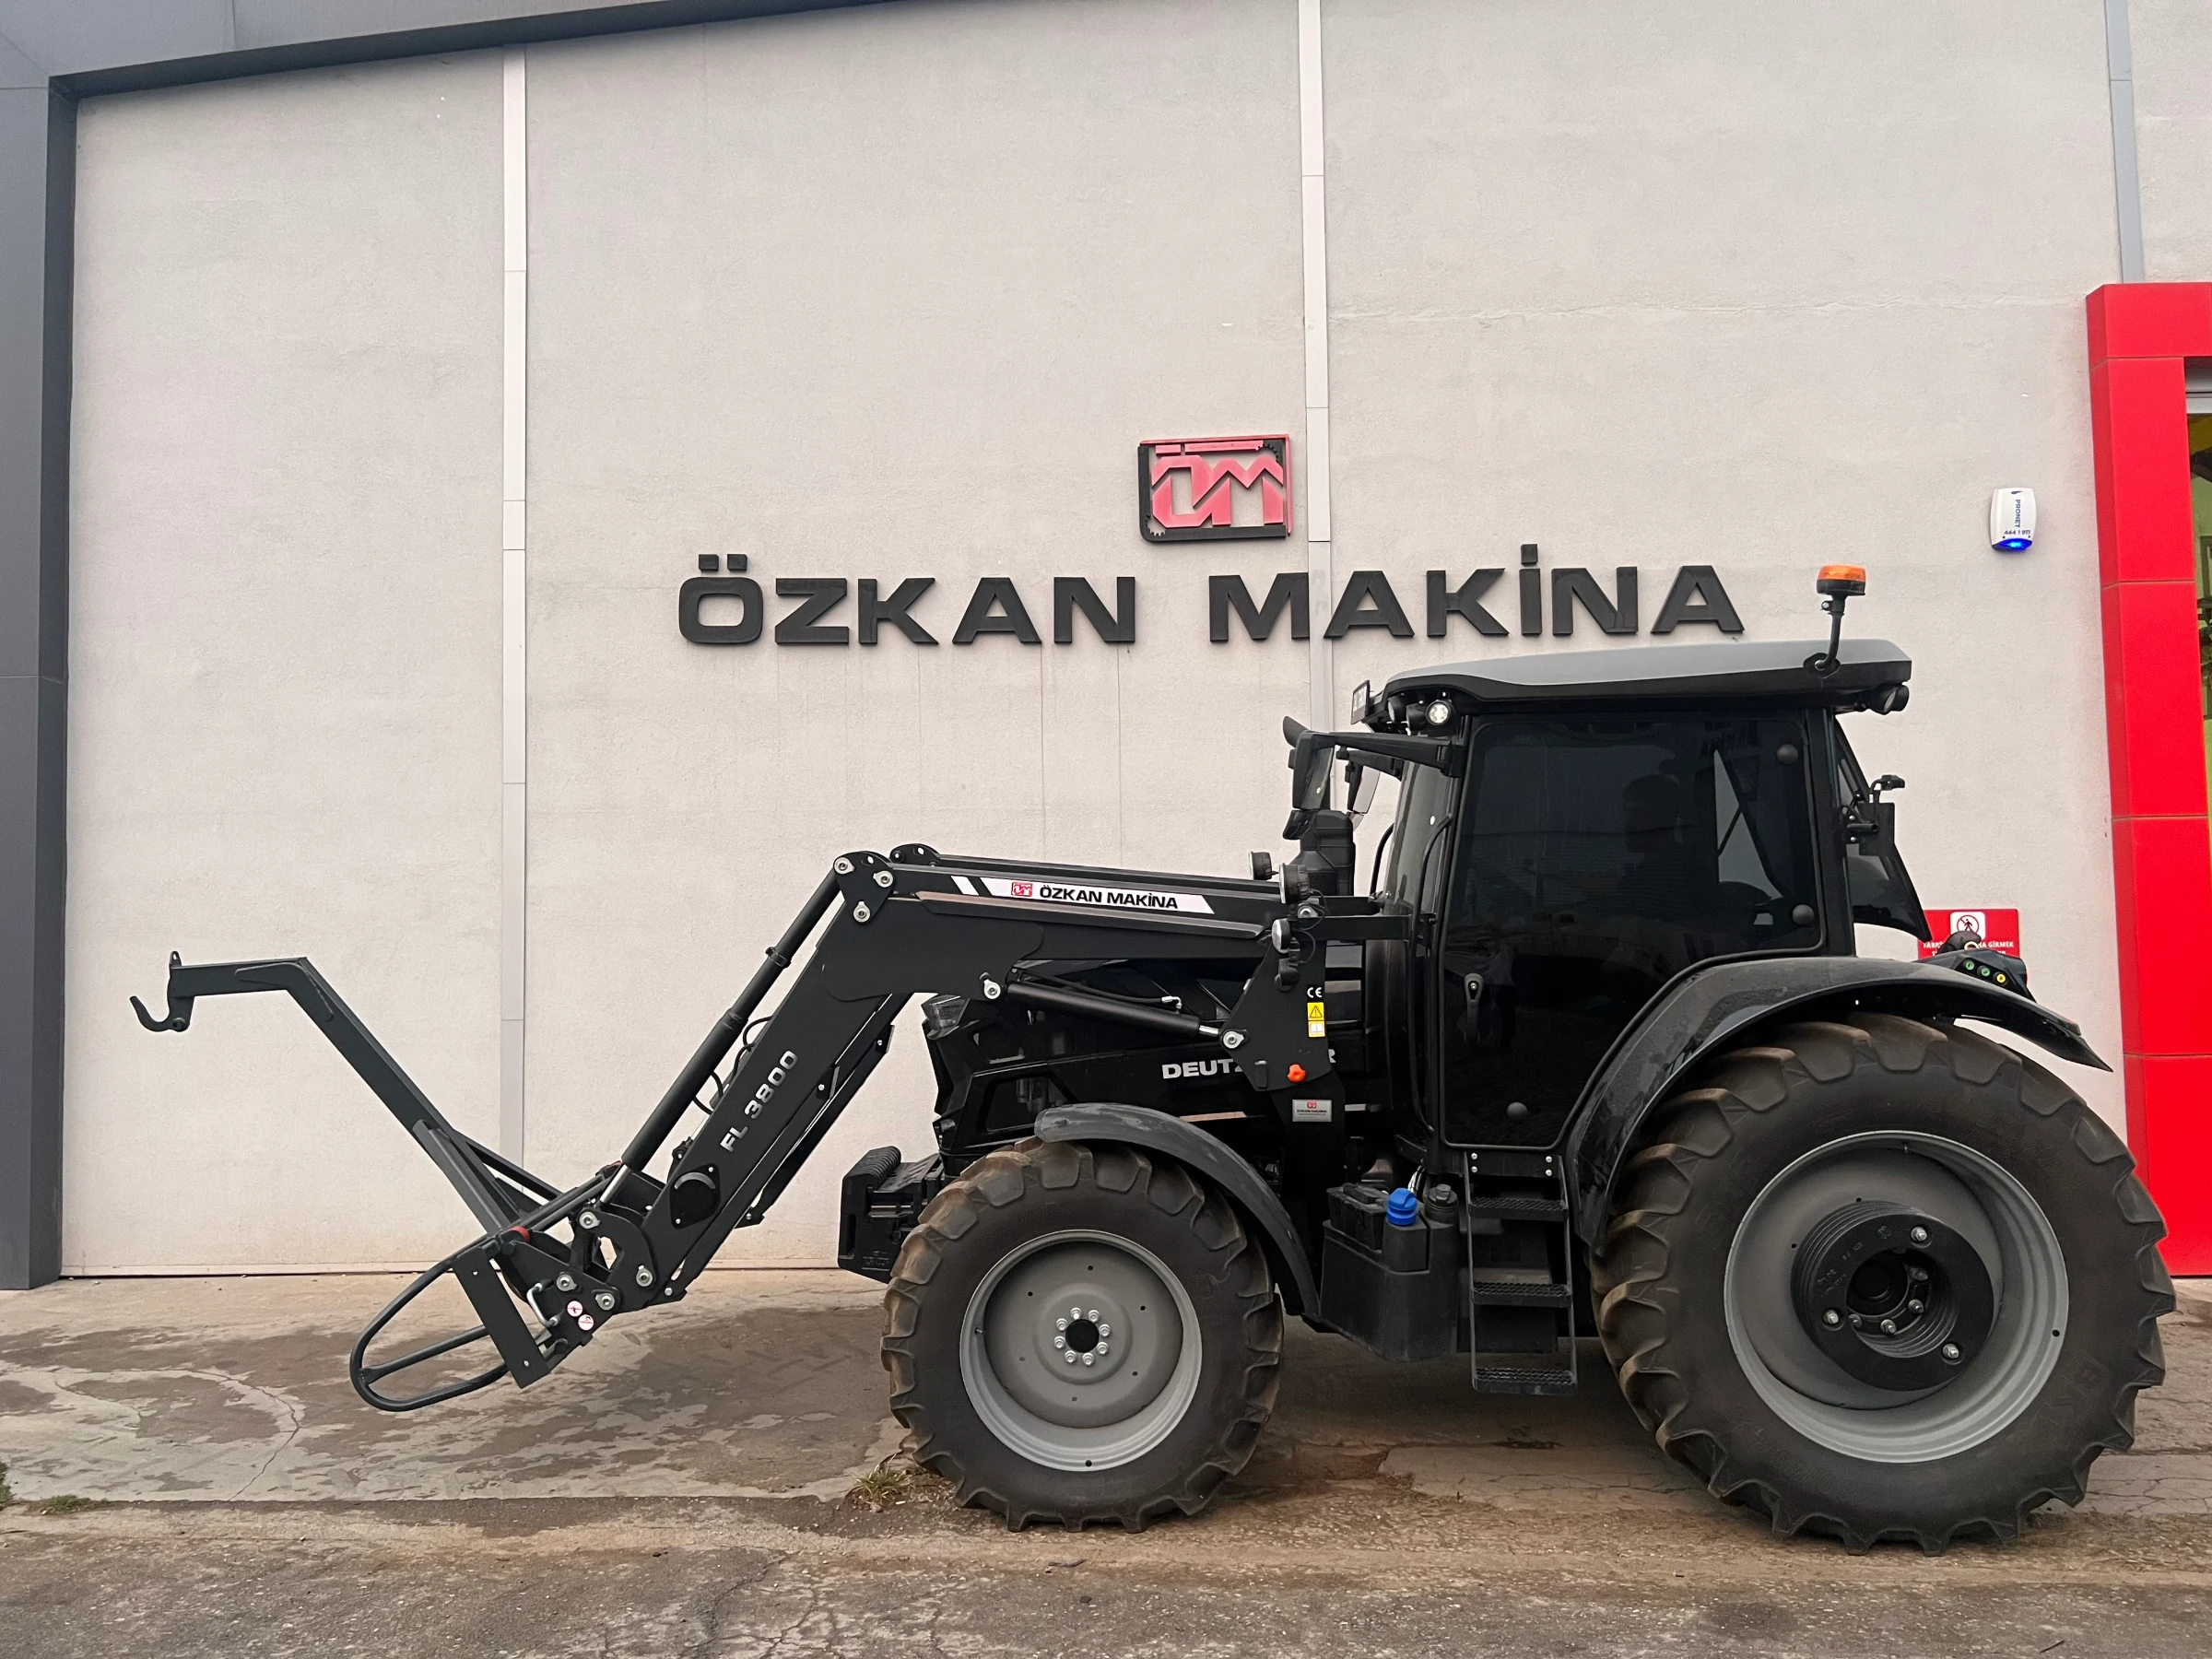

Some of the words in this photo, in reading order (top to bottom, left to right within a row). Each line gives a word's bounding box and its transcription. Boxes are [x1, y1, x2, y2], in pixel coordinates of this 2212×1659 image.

[678, 554, 1135, 646] ÖZKAN
[1209, 544, 1745, 643] MAKİNA
[1040, 885, 1102, 903] ÖZKAN
[1107, 892, 1179, 910] MAKİNA
[1307, 986, 1323, 998] CE
[1161, 1058, 1243, 1079] DEUT
[720, 1126, 749, 1153] FL
[744, 1051, 798, 1120] 3800
